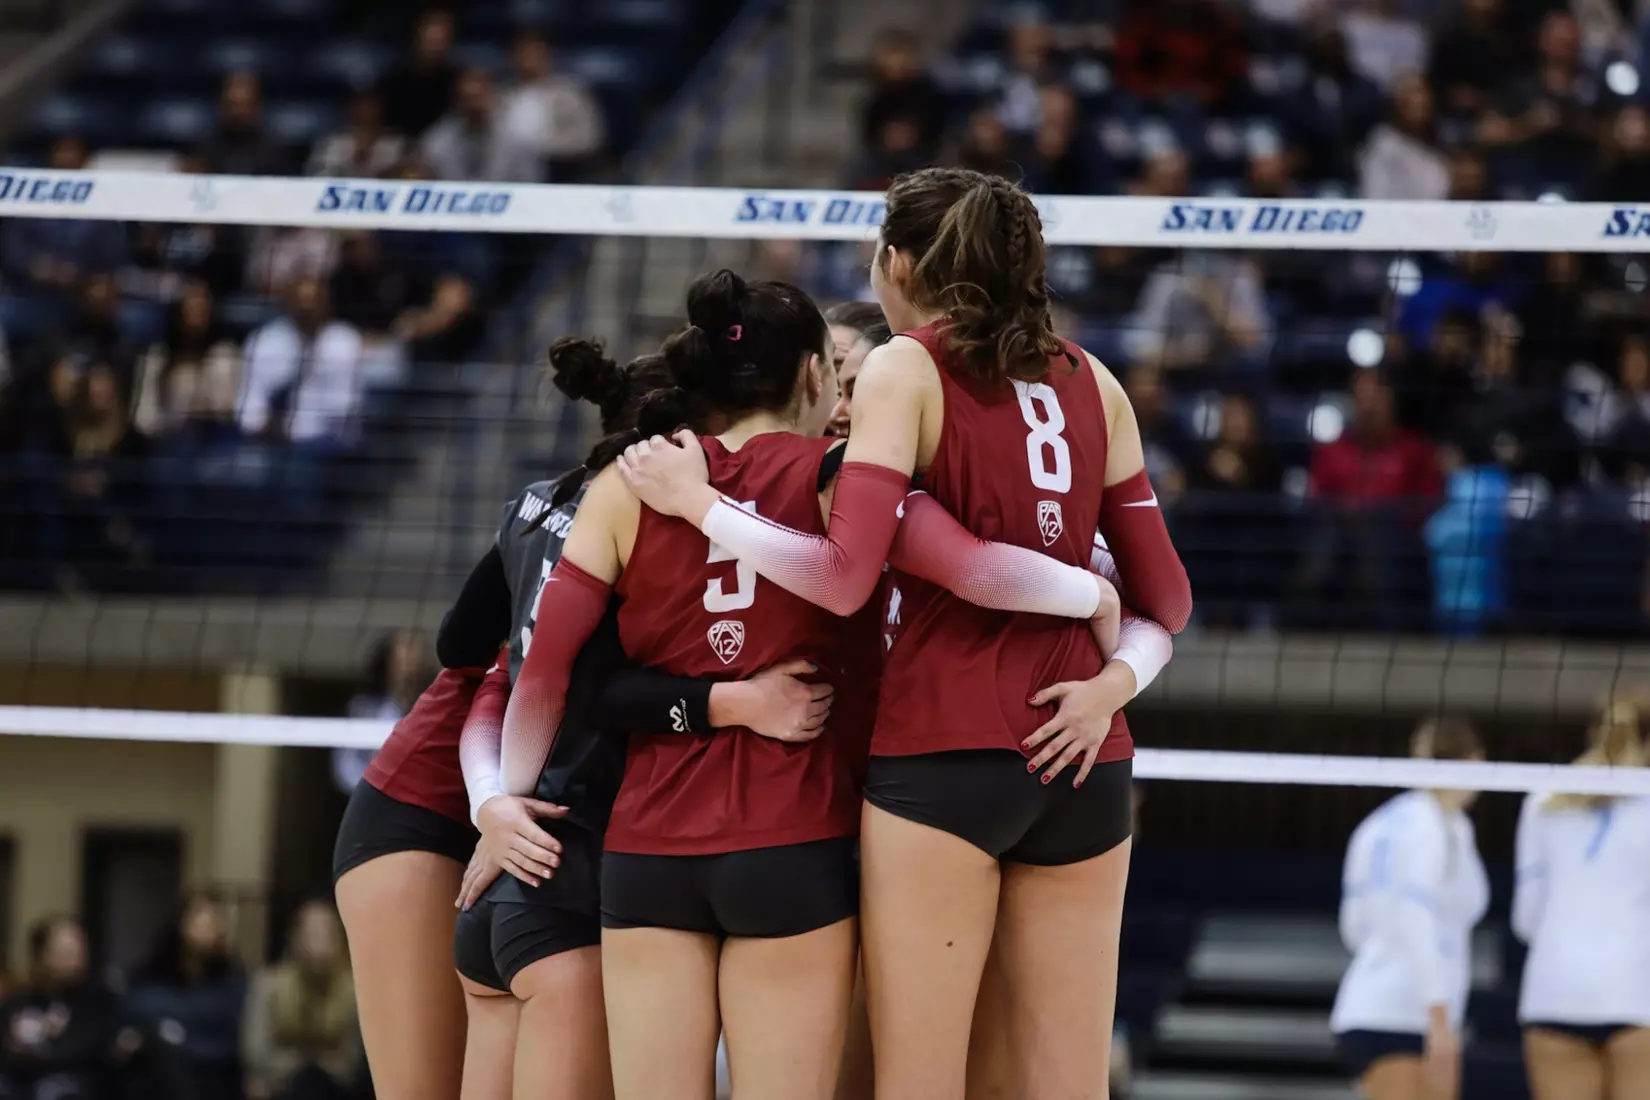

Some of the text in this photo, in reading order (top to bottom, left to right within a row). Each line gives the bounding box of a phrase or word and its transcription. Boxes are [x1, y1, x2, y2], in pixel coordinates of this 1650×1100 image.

[317, 184, 513, 215] SAN DIEGO
[736, 195, 887, 226] SAN DIE
[1162, 204, 1364, 233] SAN DIEGO
[1602, 208, 1650, 237] SA
[1012, 378, 1072, 494] 8
[1044, 520, 1059, 538] 12
[708, 621, 743, 647] PAC
[718, 638, 737, 656] 12
